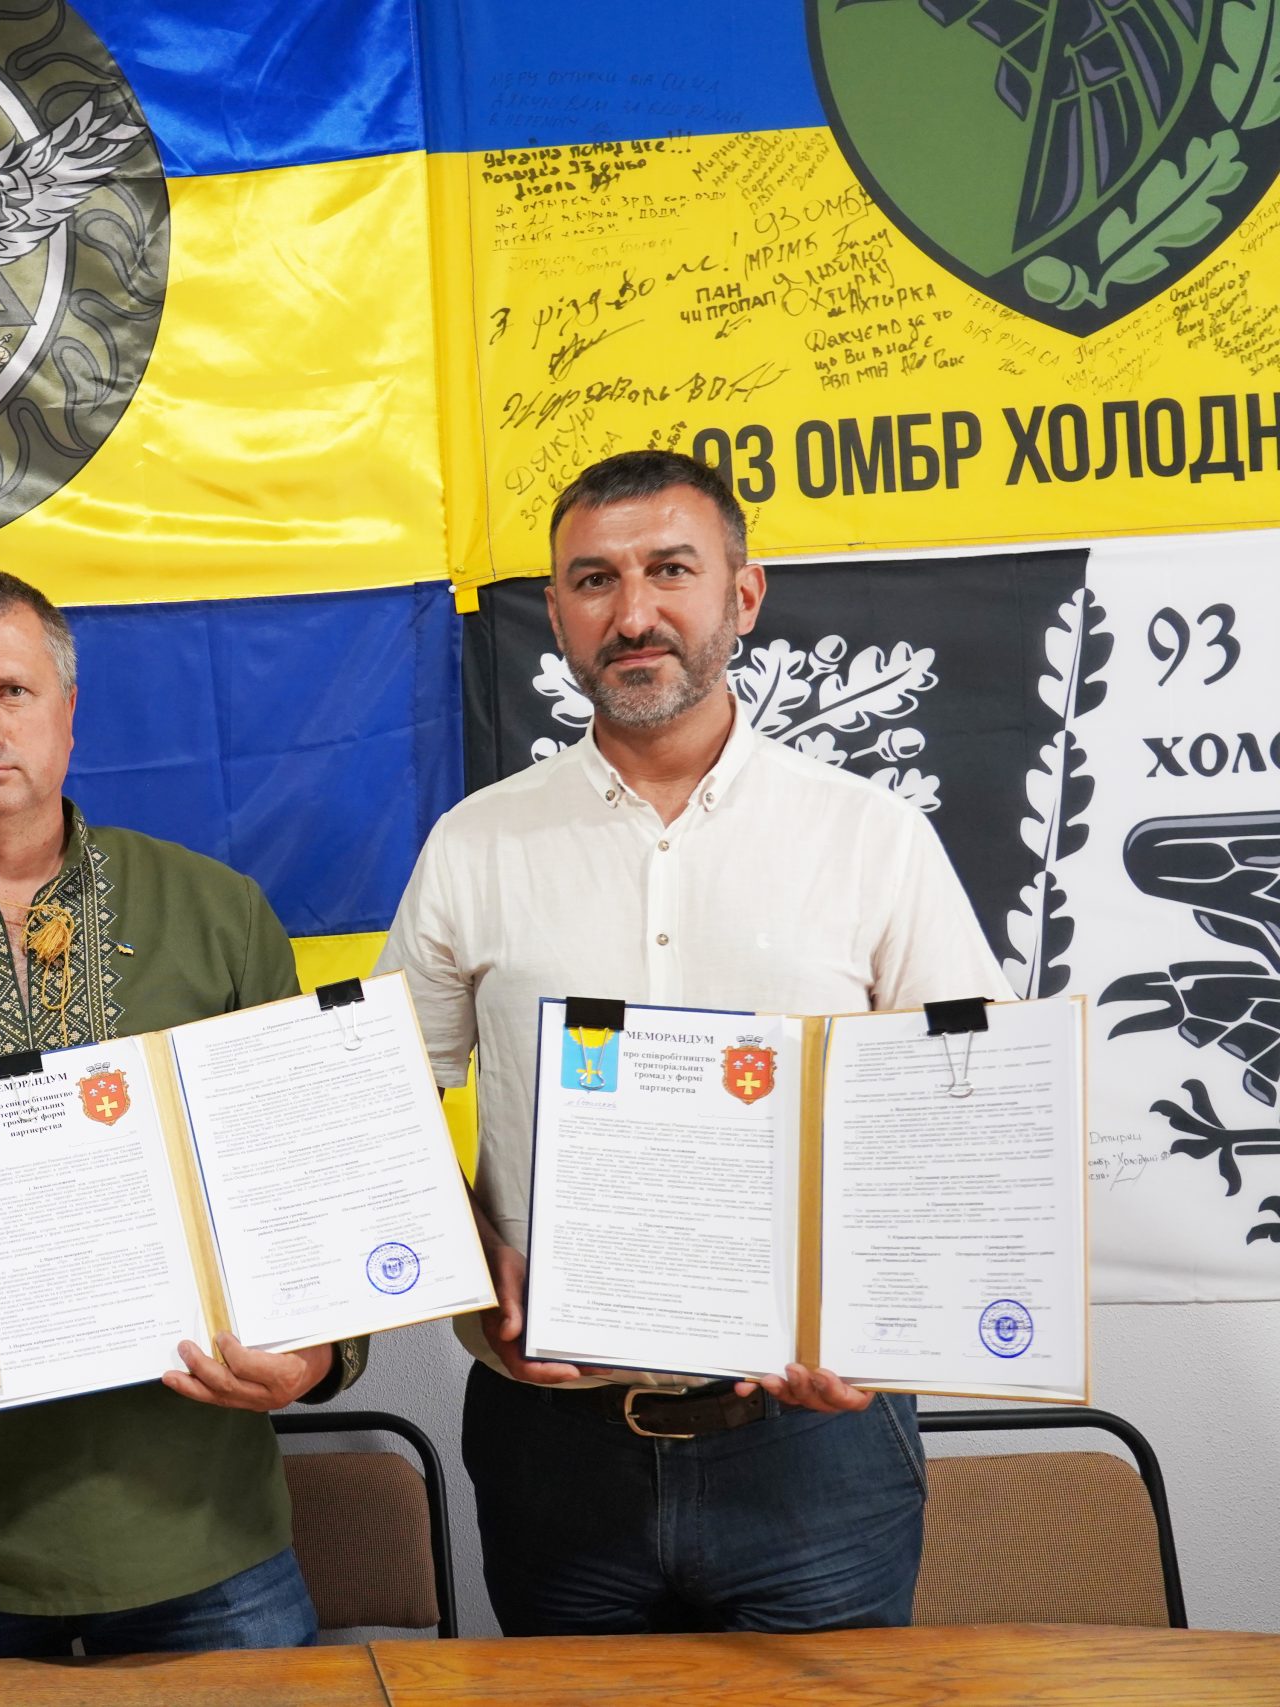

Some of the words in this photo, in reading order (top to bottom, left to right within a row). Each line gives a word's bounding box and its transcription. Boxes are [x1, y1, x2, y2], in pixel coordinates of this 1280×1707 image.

[695, 282, 742, 304] ПАН
[795, 410, 983, 499] ОМБР
[1148, 602, 1242, 686] 93
[625, 1031, 715, 1045] МЕМОРАНДУМ
[623, 1050, 639, 1059] про
[641, 1052, 716, 1063] співробітництво
[634, 1061, 704, 1072] територіальних
[634, 1071, 666, 1080] громад
[675, 1073, 703, 1083] формі
[639, 1083, 696, 1094] партнерства
[10, 1123, 62, 1137] партнерства
